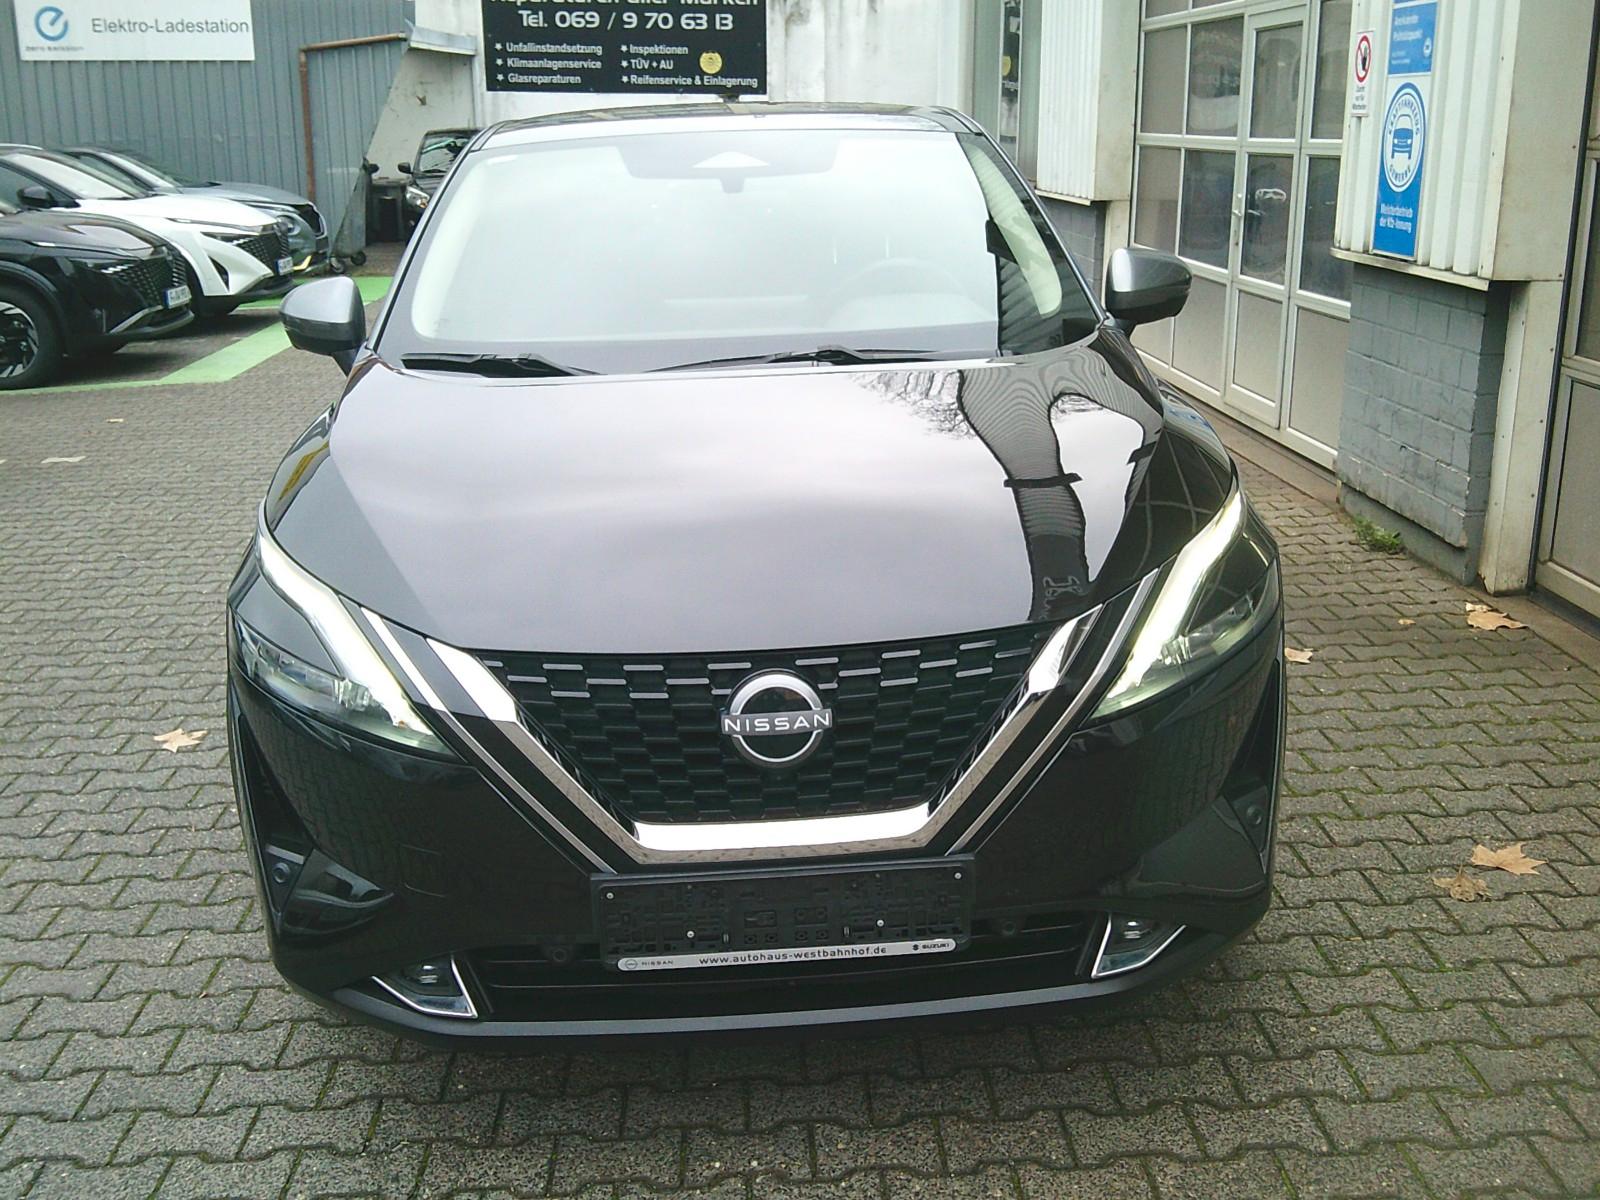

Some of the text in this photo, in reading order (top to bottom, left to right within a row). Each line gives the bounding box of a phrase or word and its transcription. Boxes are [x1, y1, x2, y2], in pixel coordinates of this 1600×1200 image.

[91, 18, 249, 33] Elektro-Ladestation
[518, 10, 733, 30] Tel. 069 / 9 70 63 13
[506, 42, 602, 55] Unfallinstandsetzung
[630, 44, 688, 55] Inspektionen
[507, 58, 602, 70] Klimaanlagenservice
[630, 58, 649, 69] TÜV
[660, 60, 673, 69] AU
[508, 73, 581, 84] Glasreparaturen
[630, 75, 758, 87] Reifenservice & Einlagerung
[724, 712, 829, 732] NISSAN
[700, 946, 887, 965] www.autohaus-westbahnhof.de
